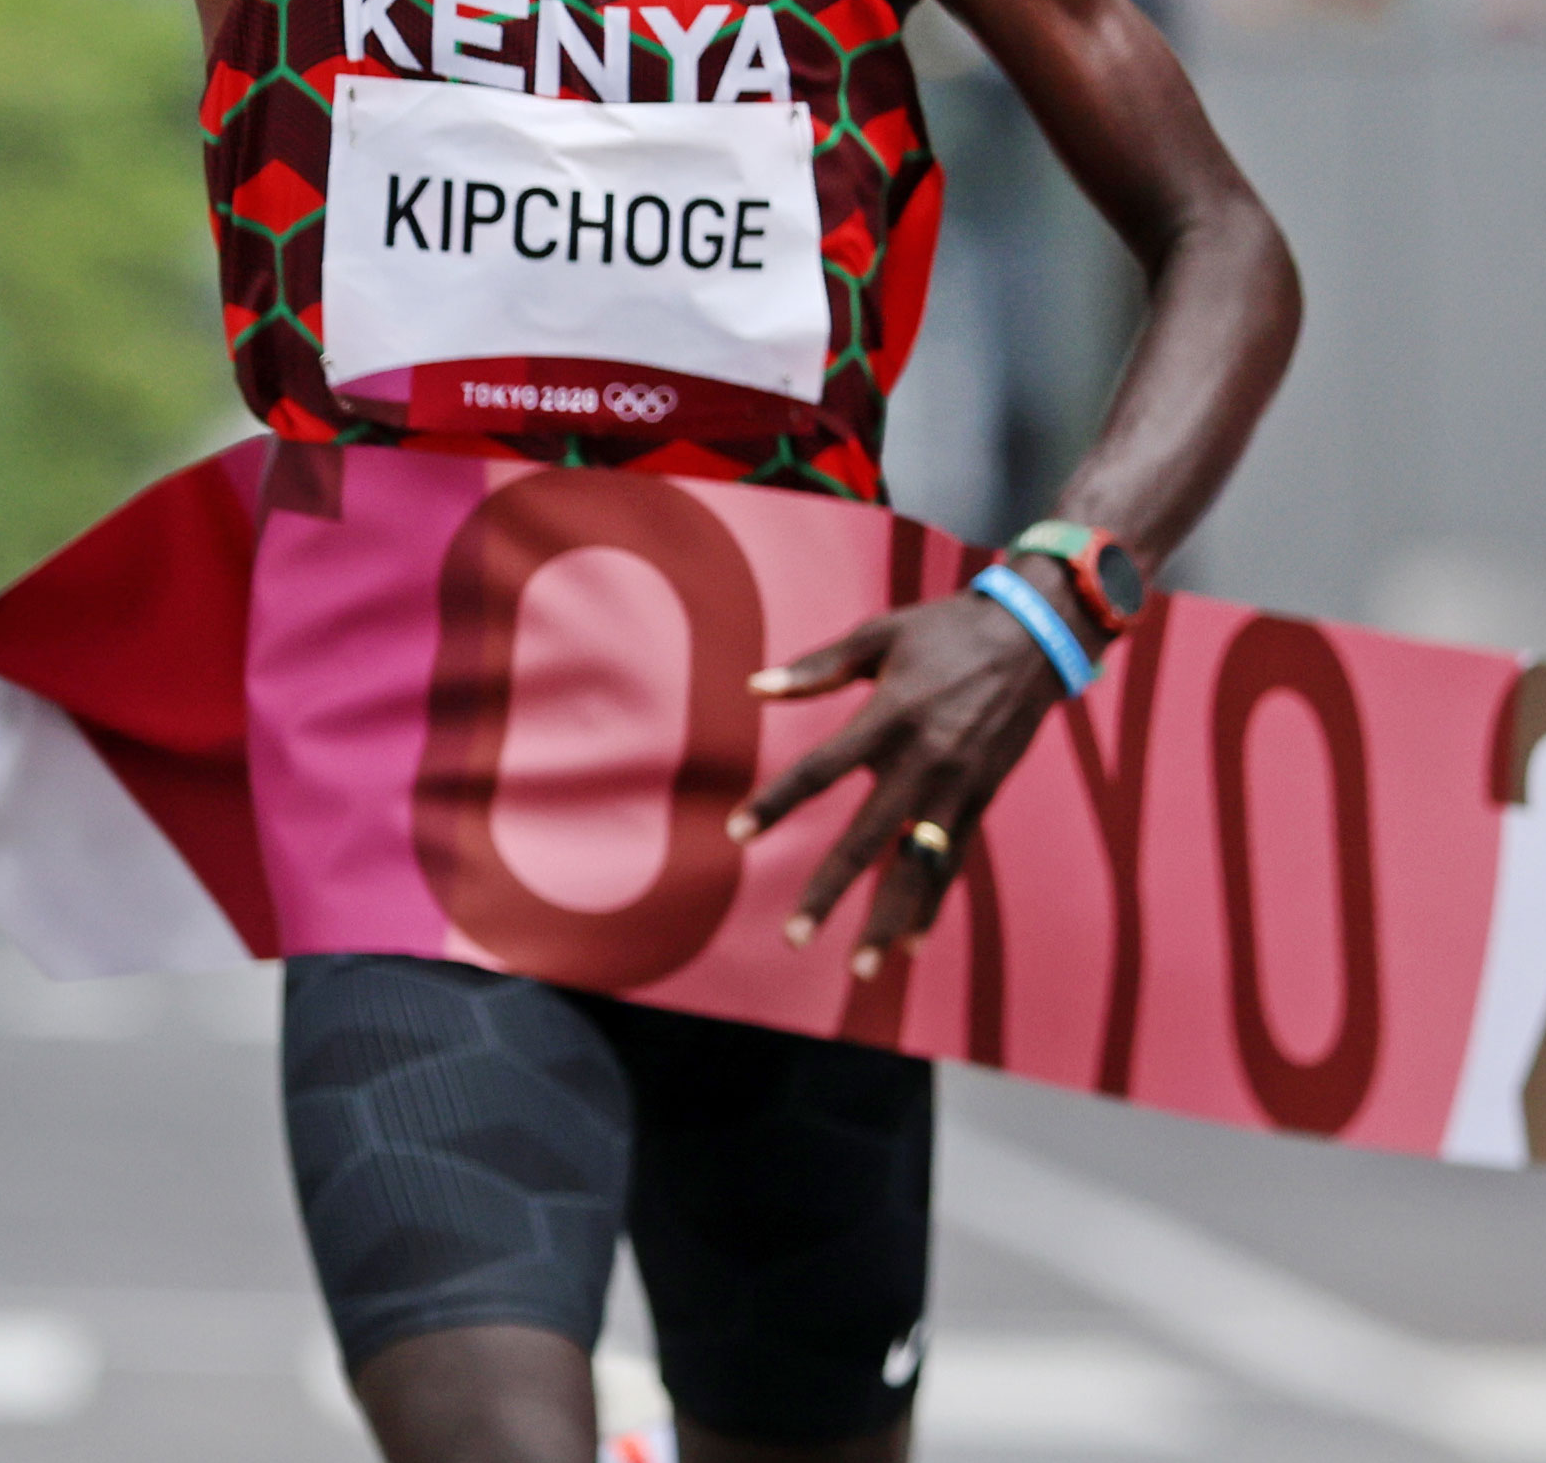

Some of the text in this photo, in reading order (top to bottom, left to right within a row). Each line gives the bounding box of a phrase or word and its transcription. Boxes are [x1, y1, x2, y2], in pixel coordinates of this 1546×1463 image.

[384, 176, 770, 270] KIPCHOGE
[461, 382, 599, 414] TOKYO 2020
[256, 442, 1379, 1137] OYO
